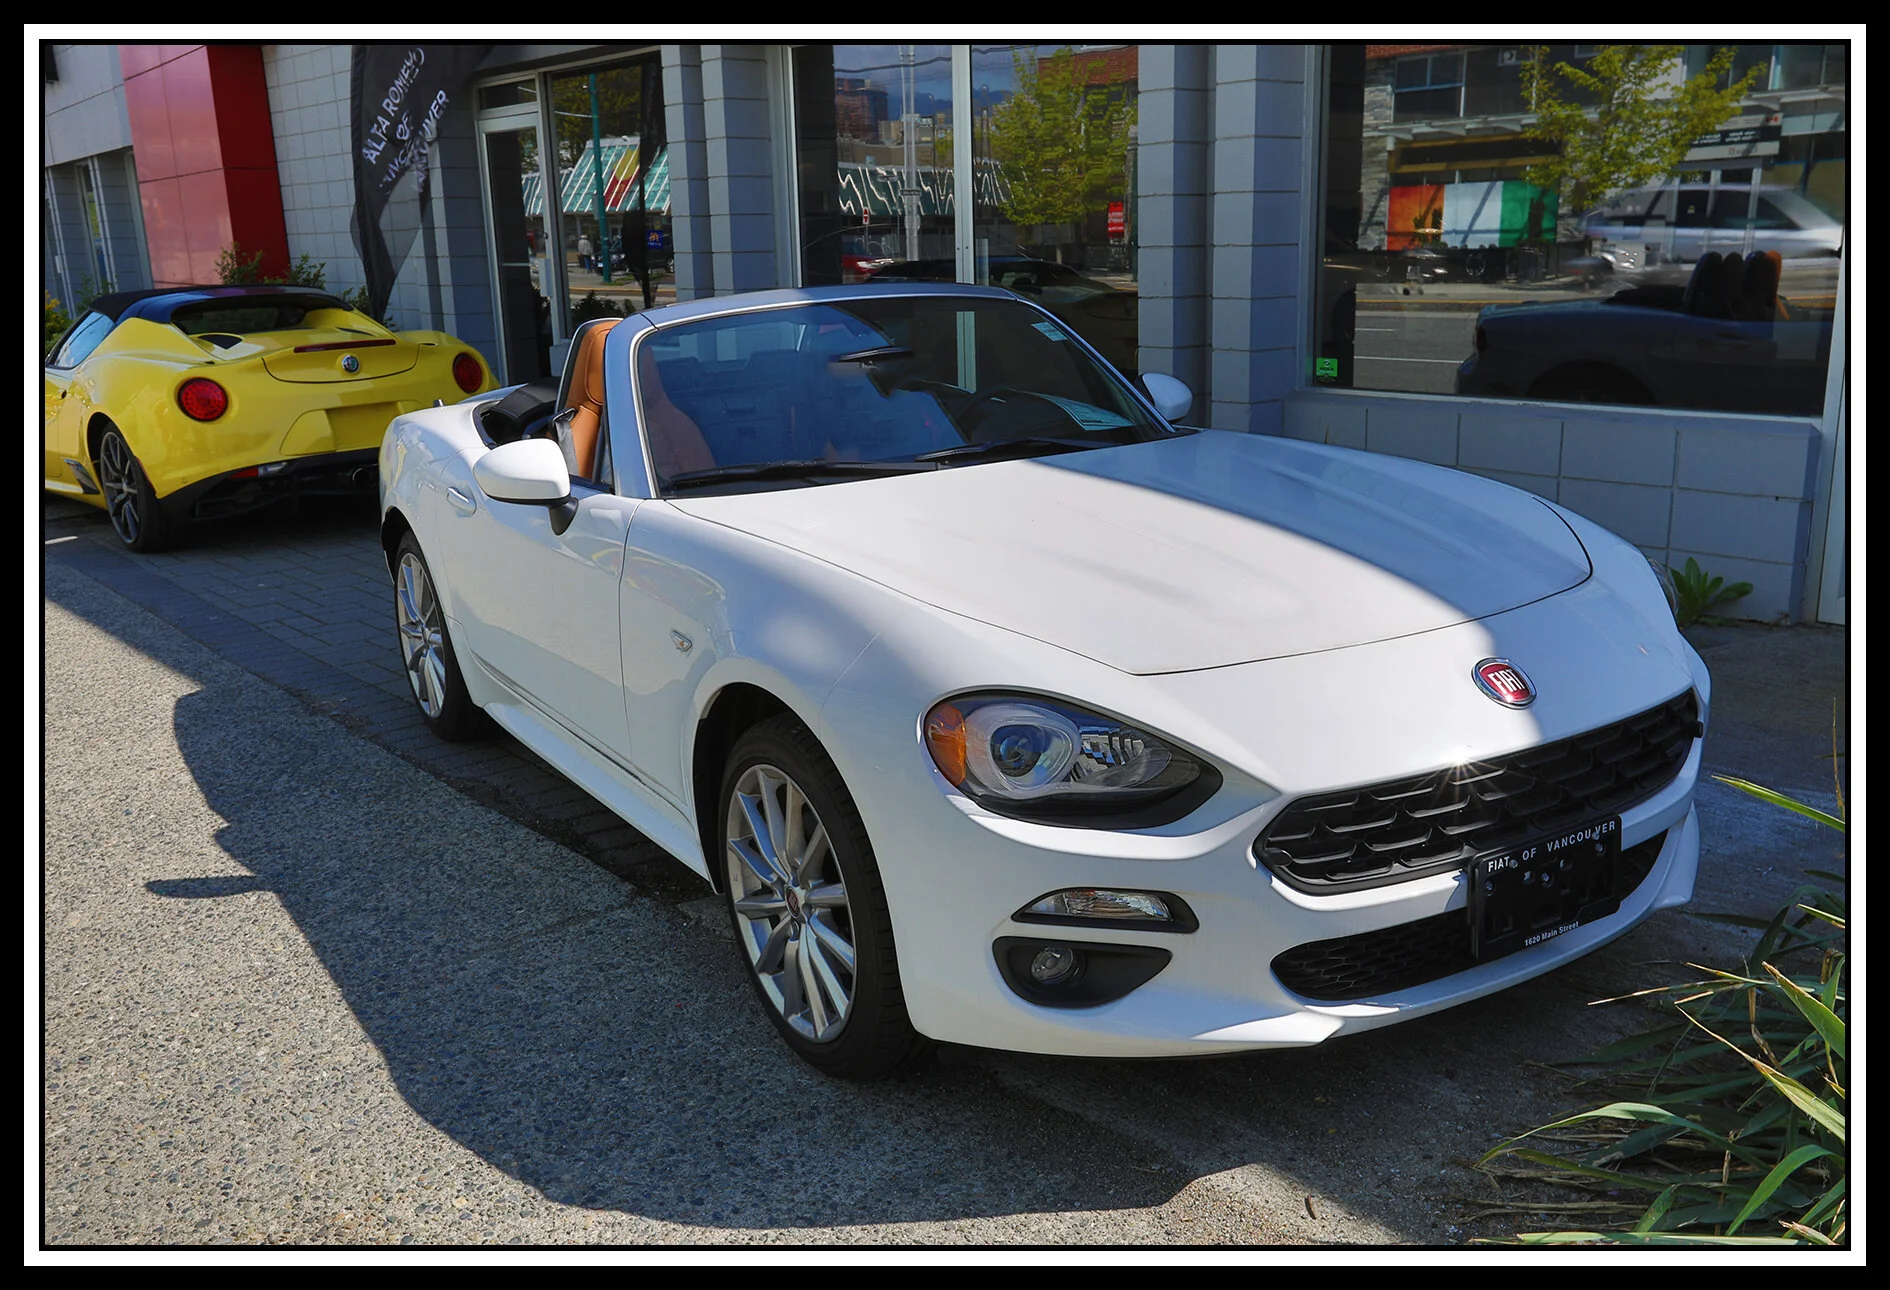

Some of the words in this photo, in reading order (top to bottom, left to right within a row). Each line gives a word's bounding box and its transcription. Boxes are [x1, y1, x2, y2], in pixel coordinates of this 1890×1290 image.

[362, 115, 391, 165] ALFA
[1487, 669, 1525, 695] FIAT
[1487, 856, 1511, 873] FIAT
[1522, 847, 1537, 861] OF
[1546, 820, 1616, 853] VANCOUVER
[1524, 935, 1541, 947] 1620
[1541, 929, 1558, 941] Main
[1558, 921, 1579, 934] Street
